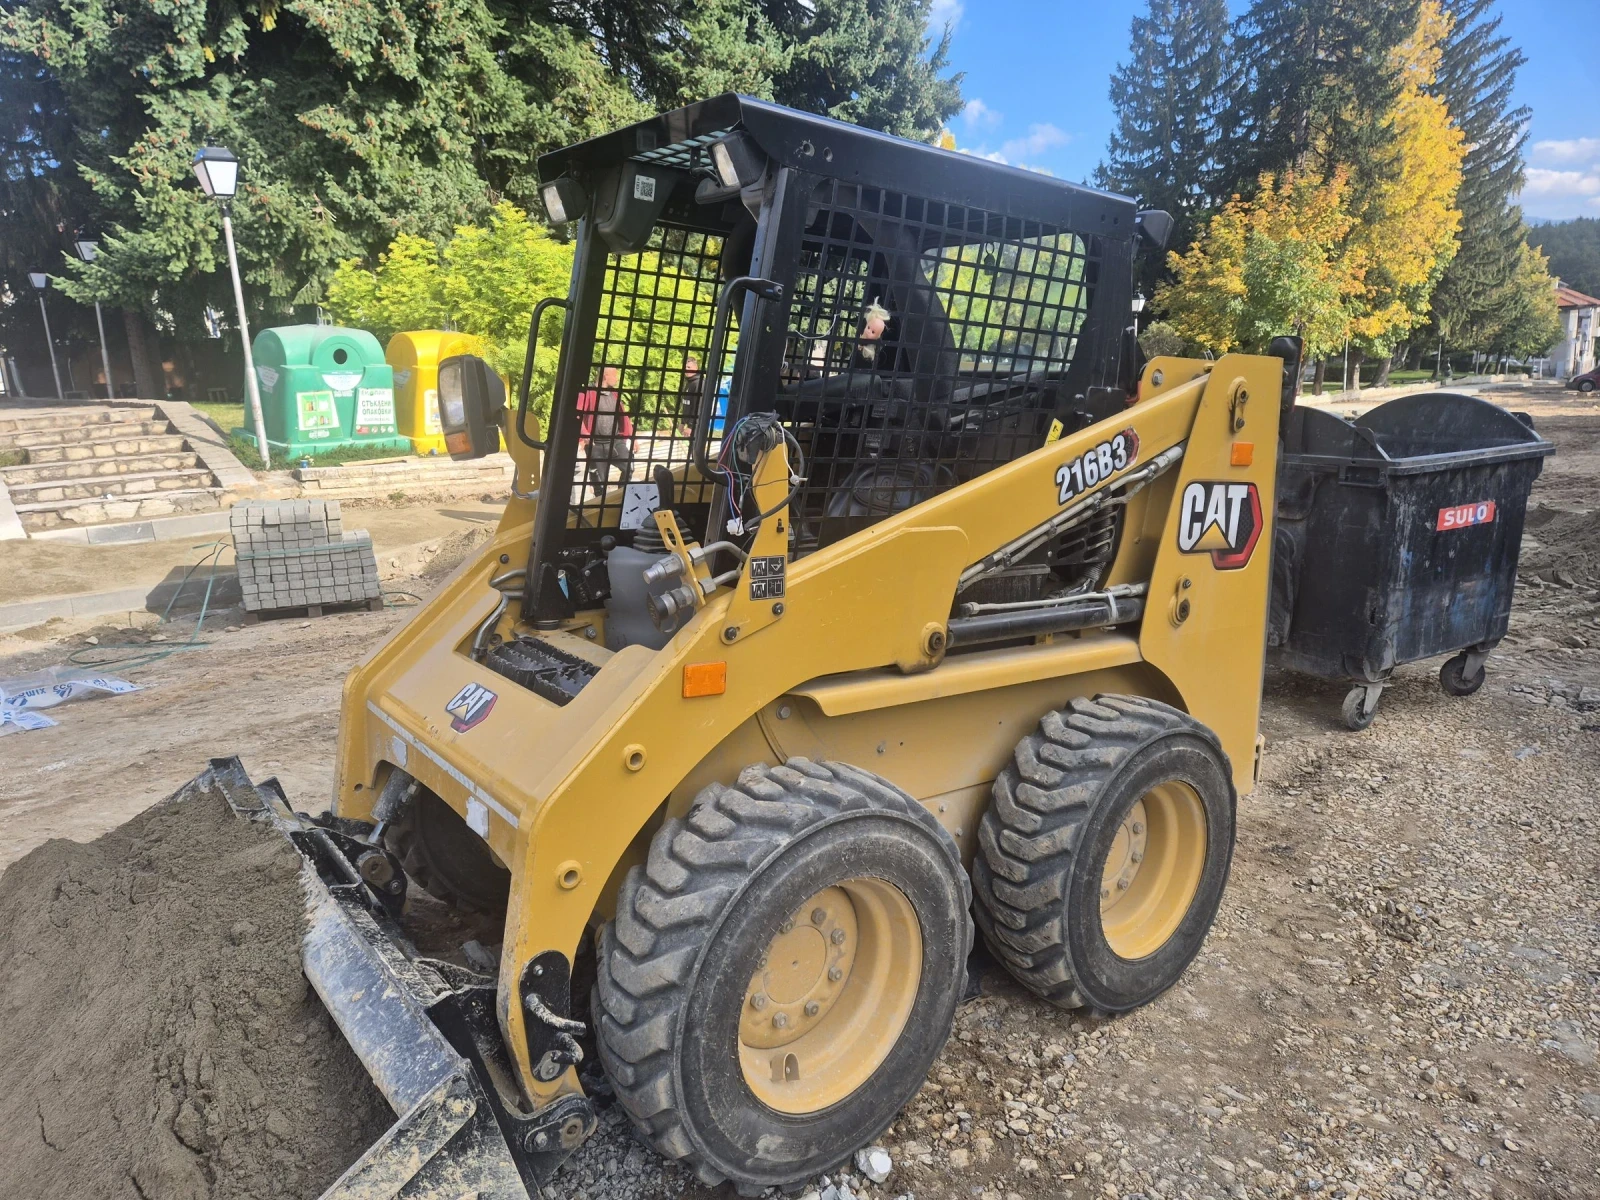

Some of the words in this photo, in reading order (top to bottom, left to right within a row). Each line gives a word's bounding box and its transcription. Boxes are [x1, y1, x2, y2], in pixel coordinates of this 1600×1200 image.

[1056, 434, 1127, 504] 216B3
[1180, 482, 1249, 551] CAT
[1443, 505, 1488, 527] SULO
[446, 682, 495, 721] CAT
